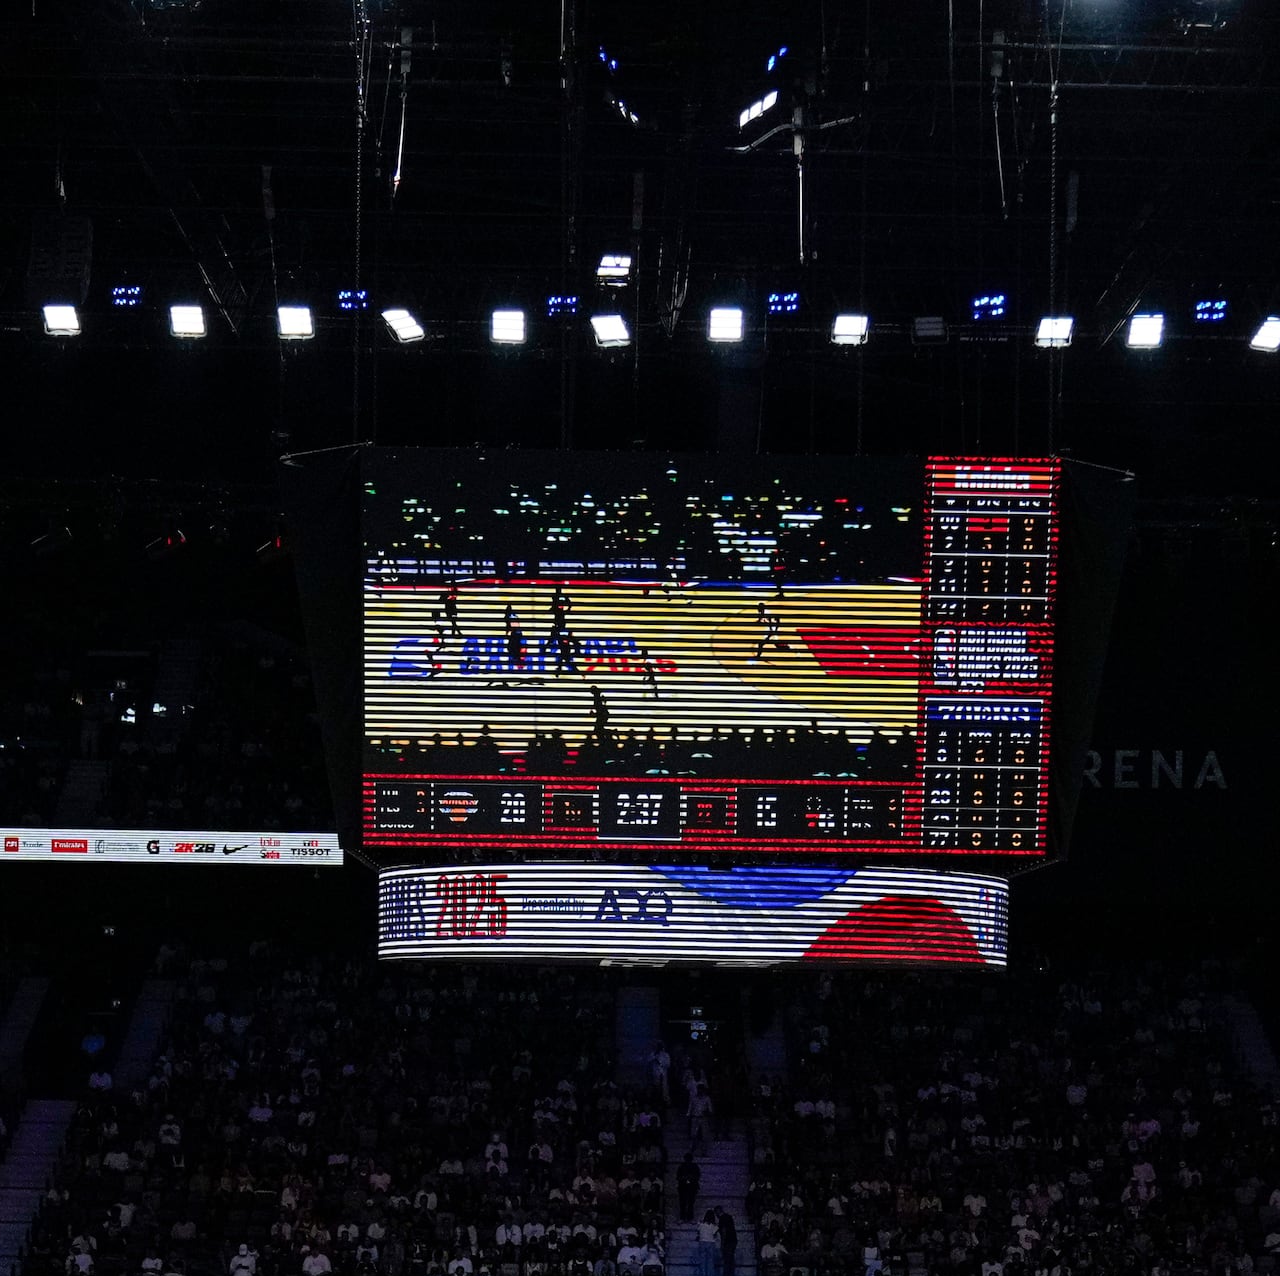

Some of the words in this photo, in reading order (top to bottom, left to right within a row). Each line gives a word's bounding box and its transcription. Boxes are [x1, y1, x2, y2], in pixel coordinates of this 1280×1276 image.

[1082, 750, 1229, 789] RENA
[290, 848, 332, 856] TISSOT
[436, 874, 509, 937] 2025
